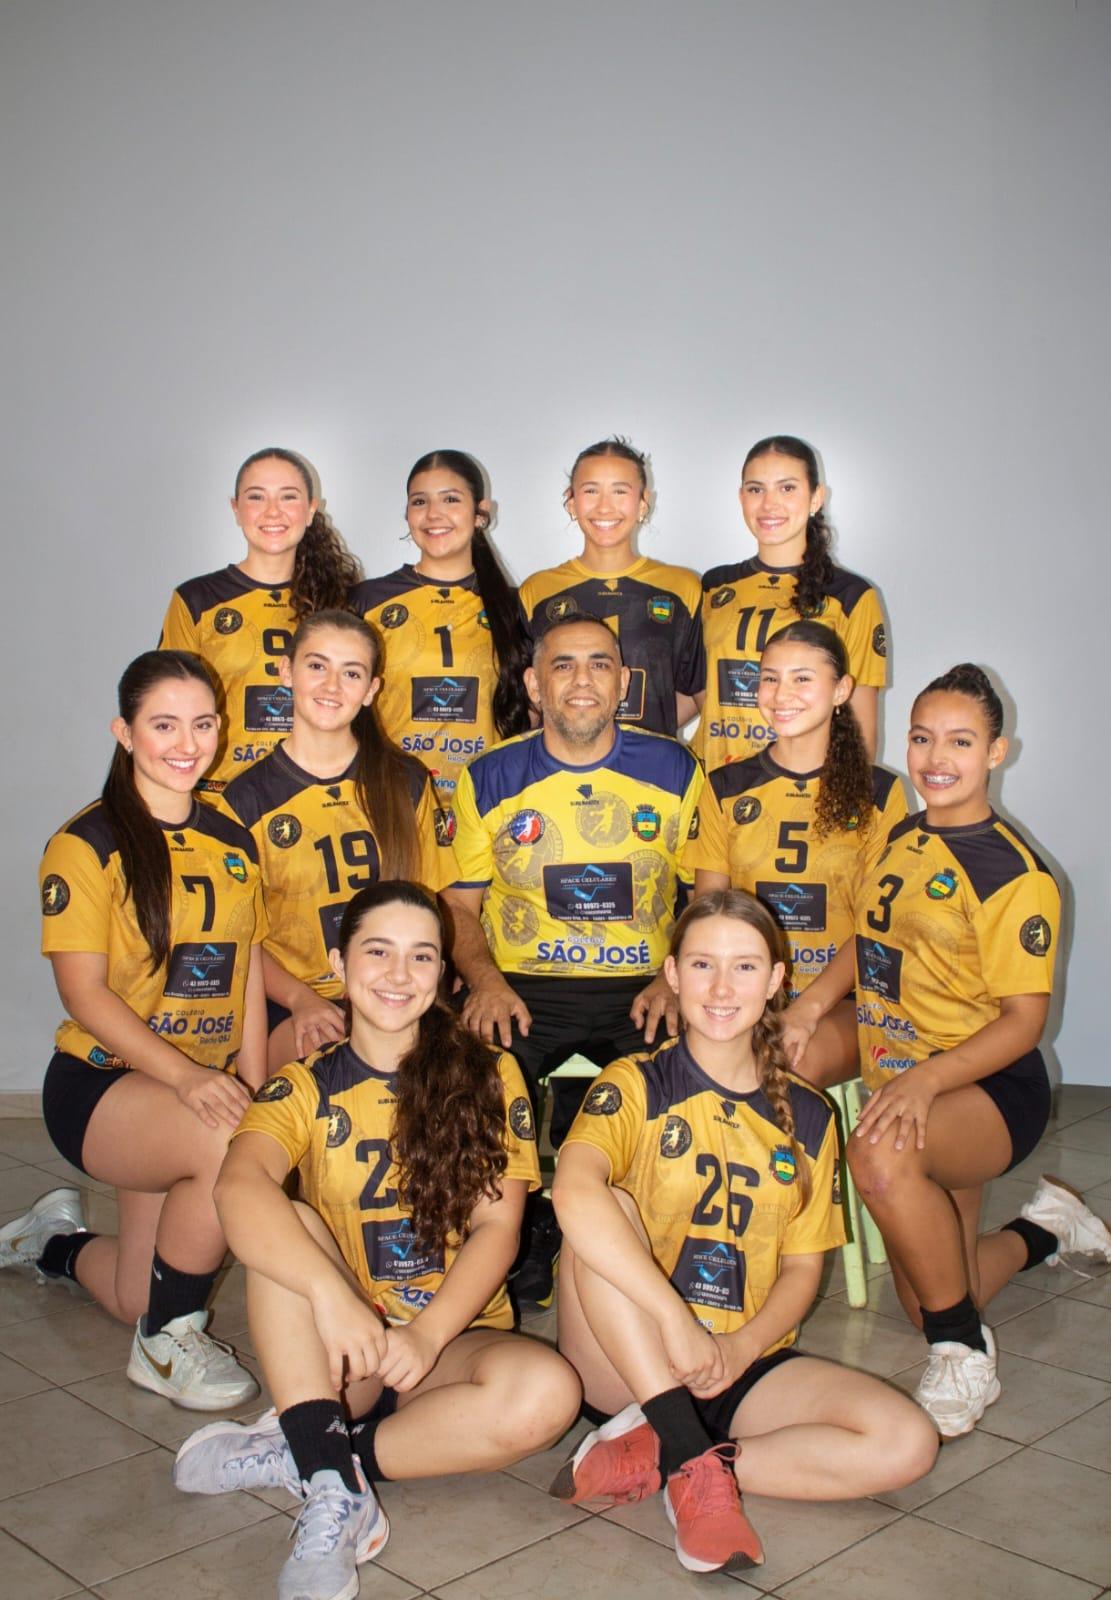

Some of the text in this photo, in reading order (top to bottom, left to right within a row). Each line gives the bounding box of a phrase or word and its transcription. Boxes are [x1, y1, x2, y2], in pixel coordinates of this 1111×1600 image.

[434, 624, 454, 668] 1
[737, 606, 776, 652] 11
[262, 628, 293, 677] 9
[402, 734, 485, 753] SÃO JOSÉ
[709, 719, 778, 740] SÃO JOS
[314, 830, 380, 894] 19
[775, 821, 810, 874] 5
[181, 875, 216, 932] 7
[867, 873, 904, 933] 3
[537, 939, 650, 965] SÃO JOSÉ
[790, 943, 836, 964] JOSÉ
[148, 1010, 234, 1035] SÃO JOSÉ
[690, 1153, 760, 1238] 26
